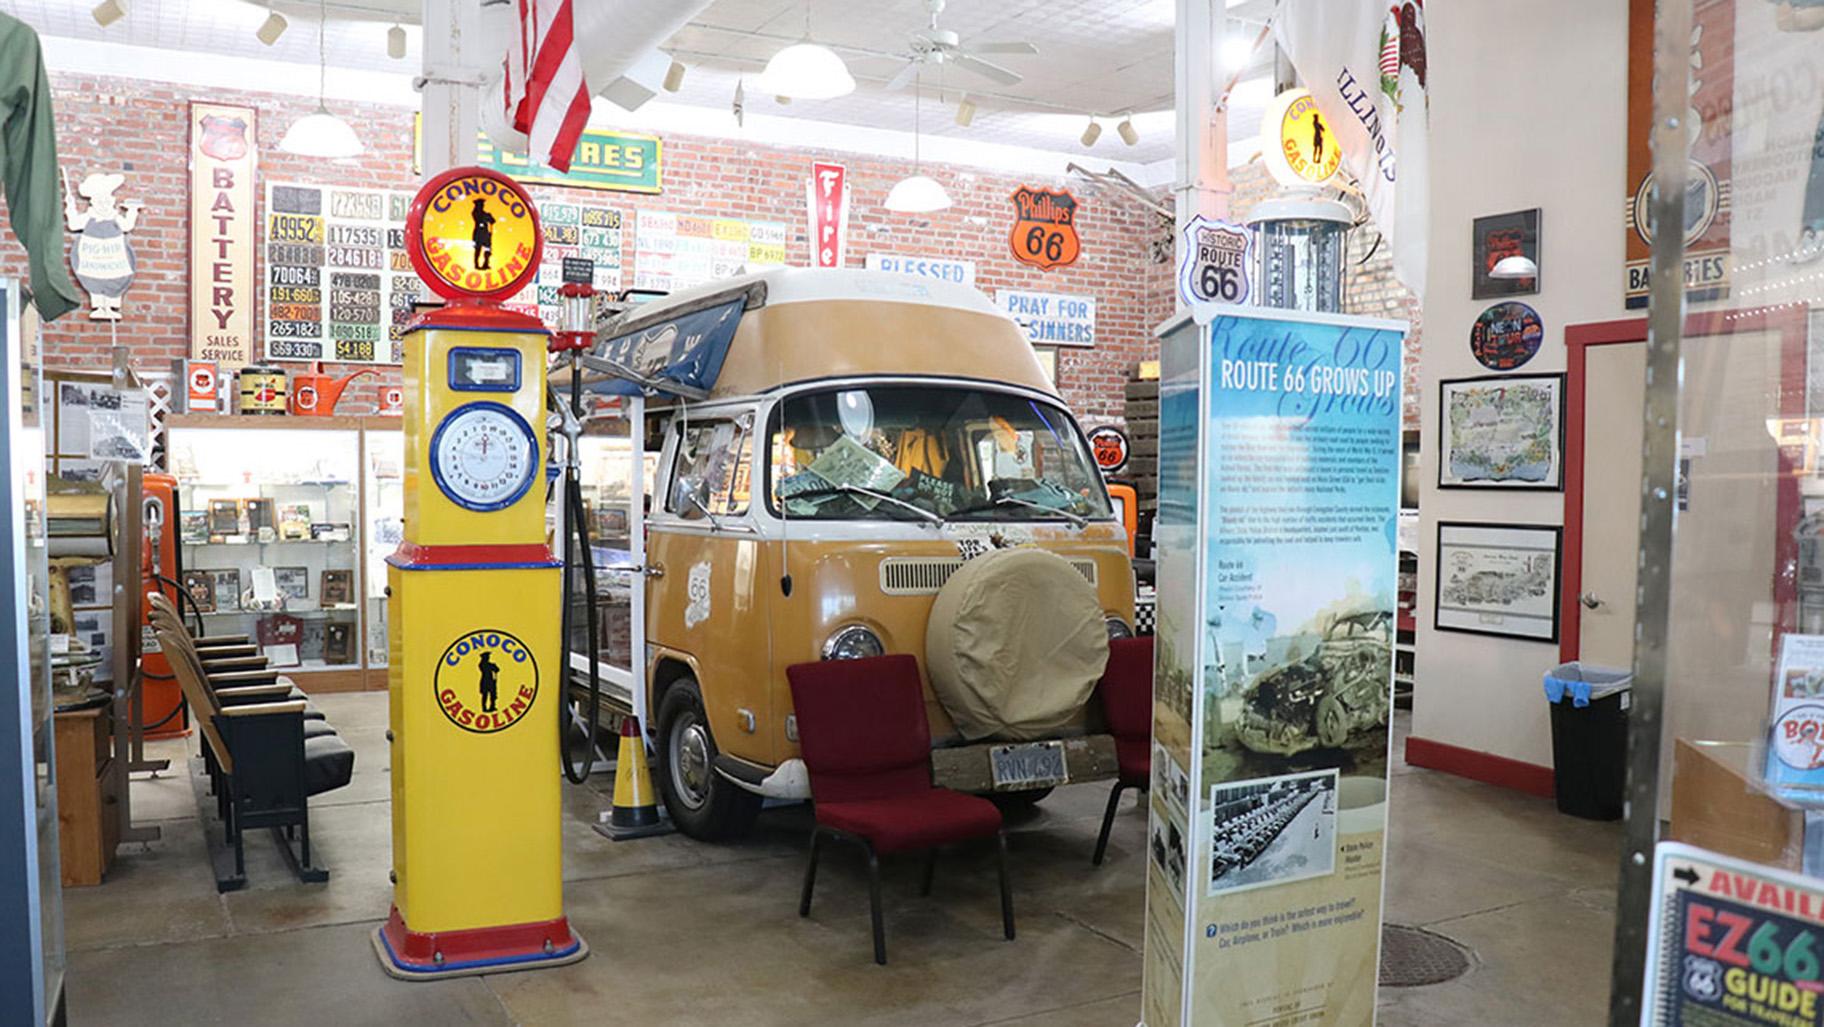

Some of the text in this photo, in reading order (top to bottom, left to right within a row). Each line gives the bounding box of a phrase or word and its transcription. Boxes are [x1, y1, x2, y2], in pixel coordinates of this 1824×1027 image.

[1289, 97, 1314, 121] CON
[1337, 65, 1396, 182] ILLINOIS
[572, 141, 643, 169] RES
[432, 179, 526, 220] CONOCO
[1018, 191, 1071, 226] Phillips
[271, 216, 316, 243] 49952
[329, 227, 377, 245] 117535
[1201, 231, 1242, 250] HISTORIC
[212, 167, 235, 330] BATTERY
[328, 248, 377, 266] 284618
[1026, 226, 1065, 262] 66
[1200, 247, 1241, 267] ROUTE
[272, 267, 311, 285] 70064
[426, 237, 532, 291] GASOLINE
[1200, 265, 1239, 301] 66
[1008, 294, 1087, 318] PRAY FOR
[207, 336, 239, 347] SALES
[1029, 319, 1092, 343] SINNERS
[202, 349, 244, 361] SERVICE
[1221, 359, 1396, 398] ROUTE 66 GROWS UP
[1098, 449, 1117, 462] 66
[691, 577, 707, 599] 66
[445, 633, 527, 667] CONOCO
[440, 684, 534, 730] GASOLINE
[998, 758, 1028, 782] RVN
[1709, 869, 1824, 922] AVAIL
[1686, 902, 1820, 982] EZ66
[1725, 967, 1818, 1020] GUIDE
